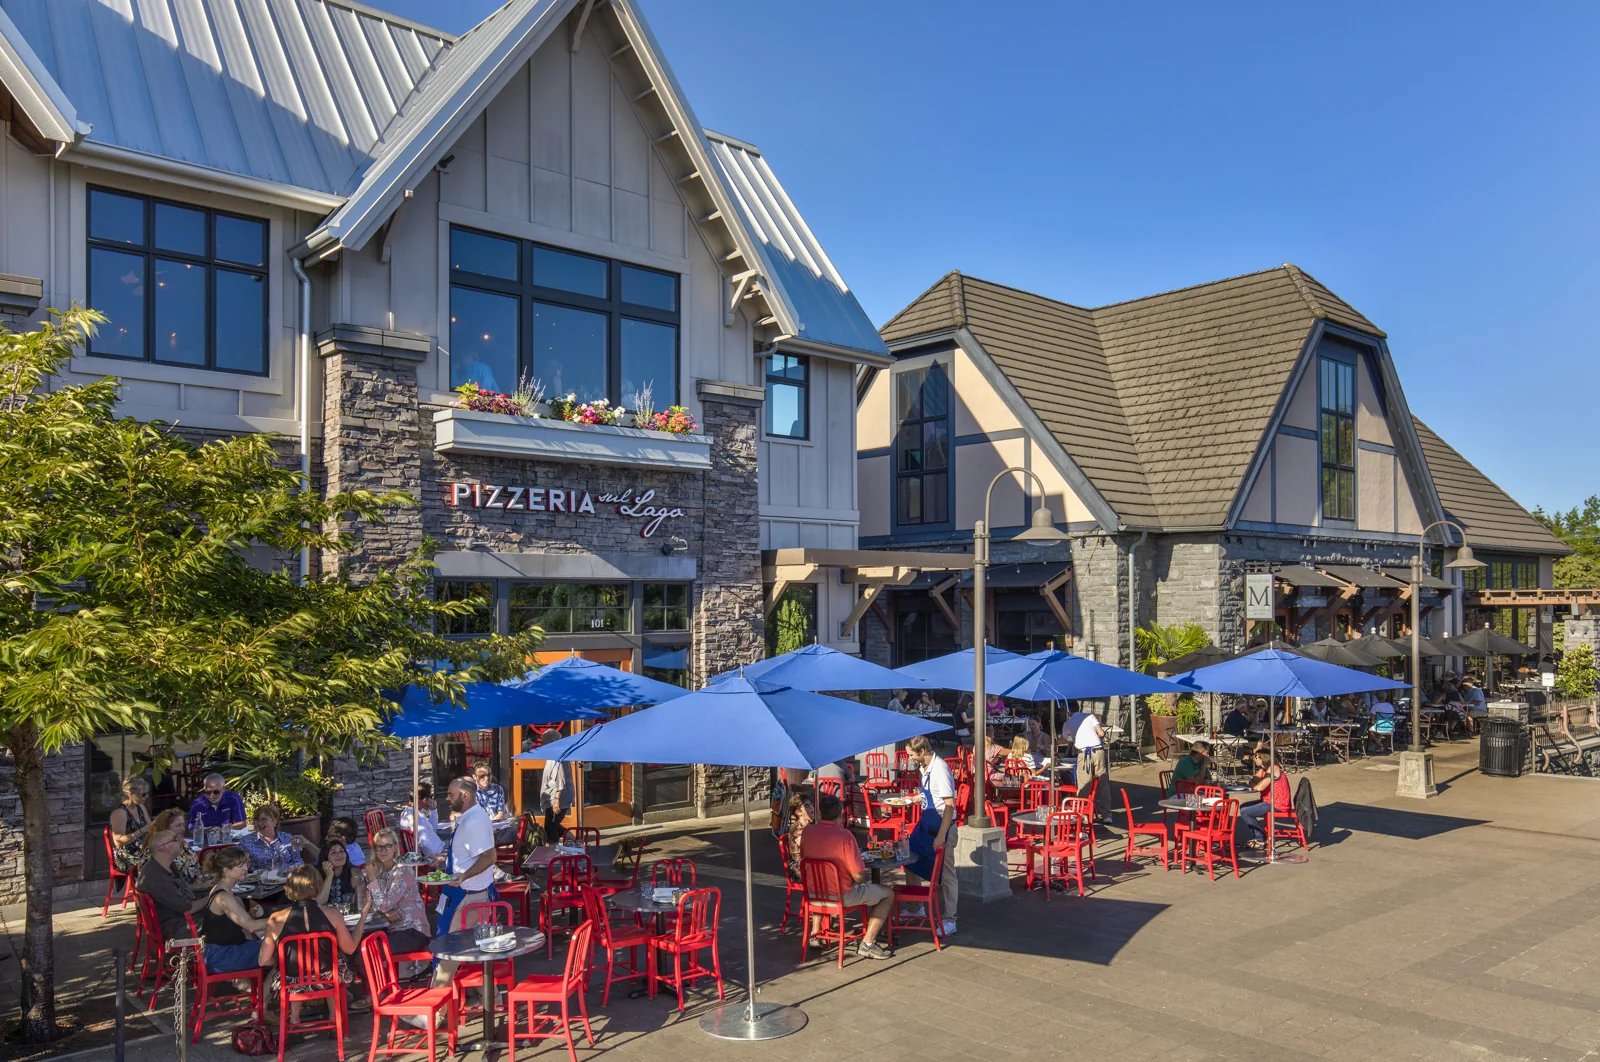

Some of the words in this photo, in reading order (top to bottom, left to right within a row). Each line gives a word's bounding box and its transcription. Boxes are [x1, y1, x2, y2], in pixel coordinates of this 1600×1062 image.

[451, 483, 595, 514] PIZZERIA
[597, 488, 629, 502] sul
[619, 489, 684, 538] Lago
[1248, 586, 1270, 606] M
[591, 618, 604, 628] 101
